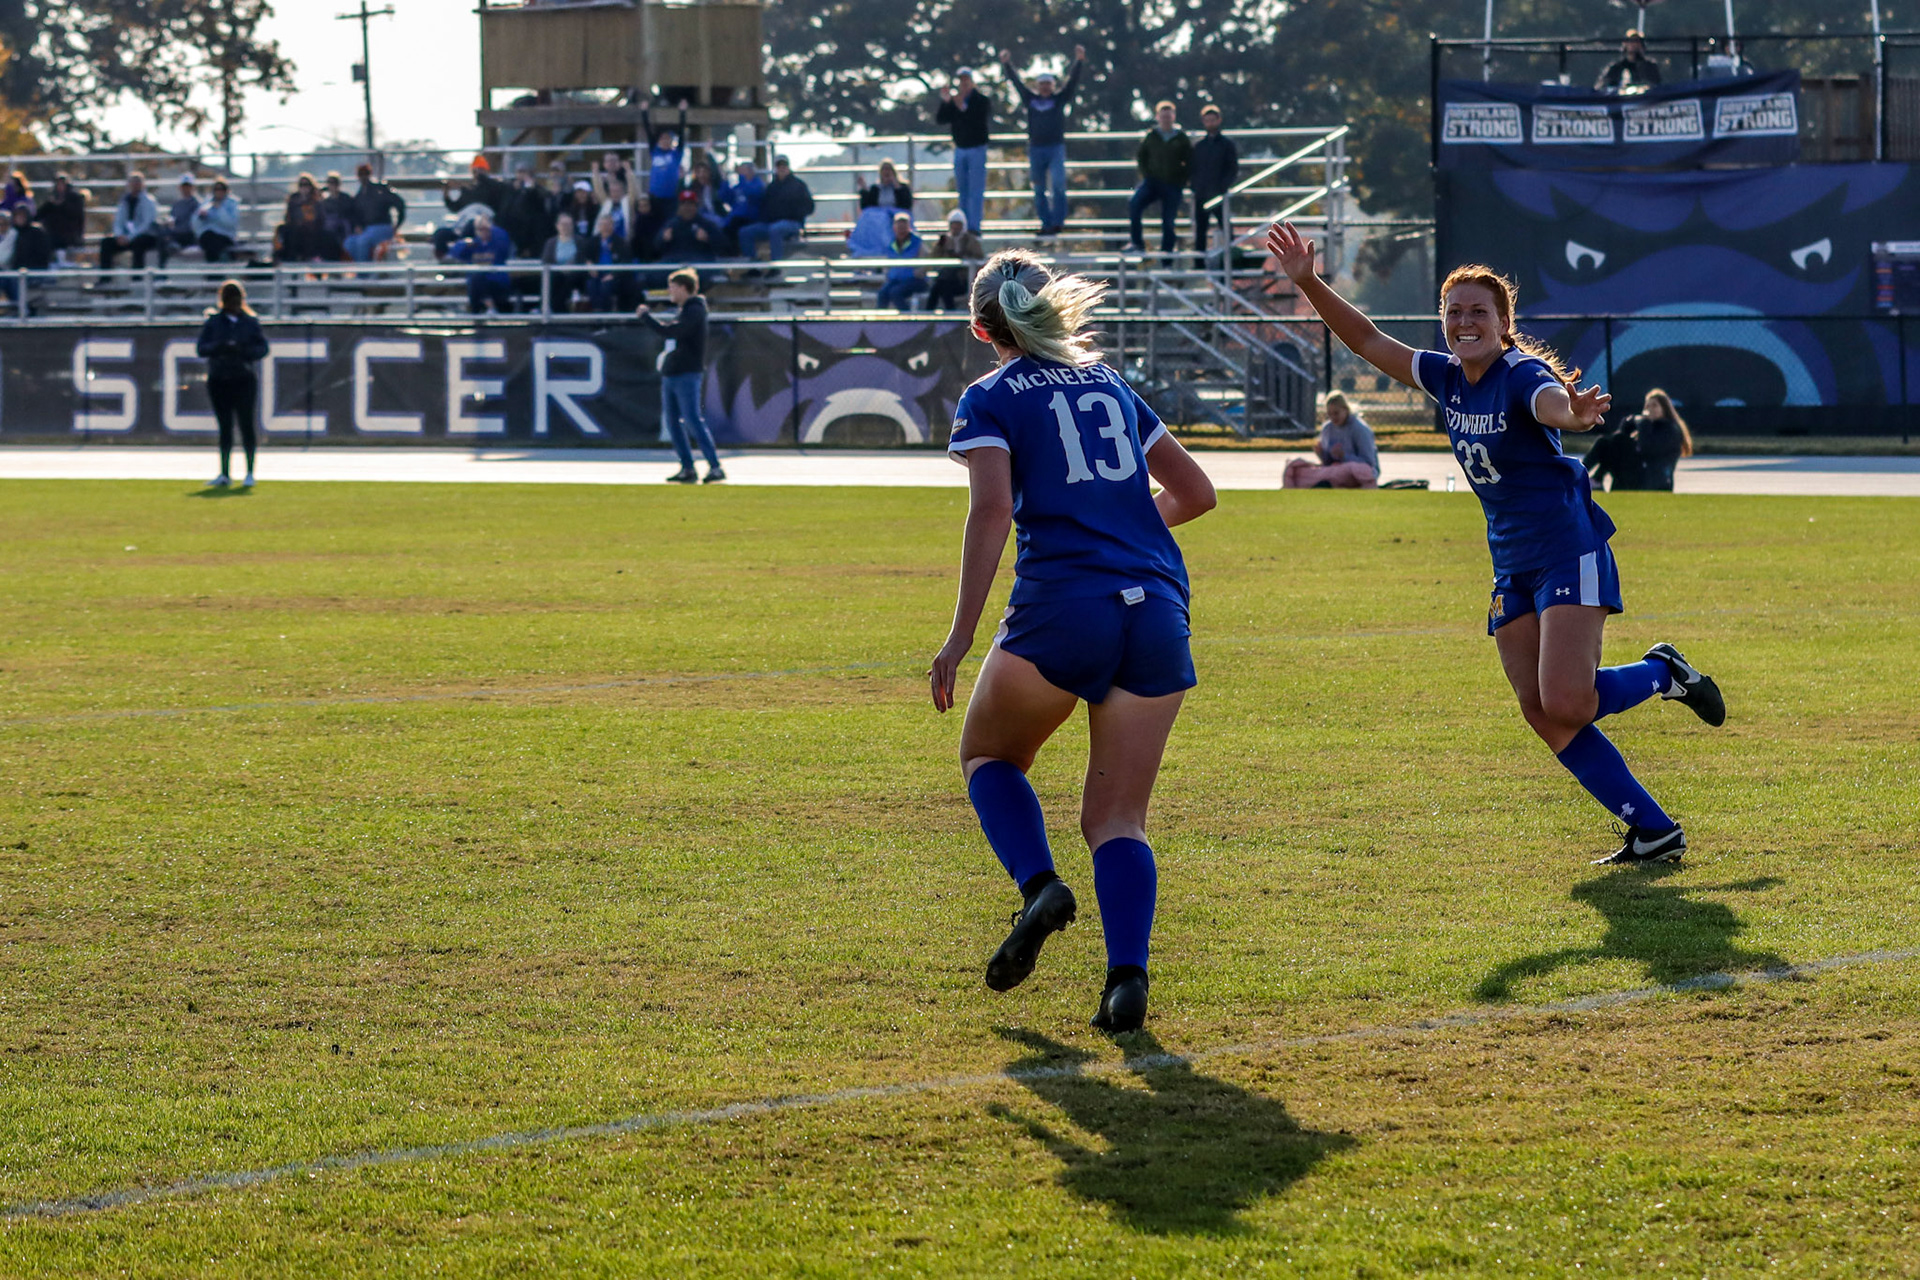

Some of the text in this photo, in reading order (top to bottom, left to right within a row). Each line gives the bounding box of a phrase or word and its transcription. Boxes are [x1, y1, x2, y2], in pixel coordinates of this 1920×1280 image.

[1448, 119, 1517, 137] STRONG
[1537, 119, 1609, 136] STRONG
[1629, 116, 1698, 135] STRONG
[1720, 110, 1792, 131] STRONG
[1445, 407, 1508, 435] COWGIRLS
[1048, 391, 1138, 484] 13
[1456, 439, 1502, 485] 23
